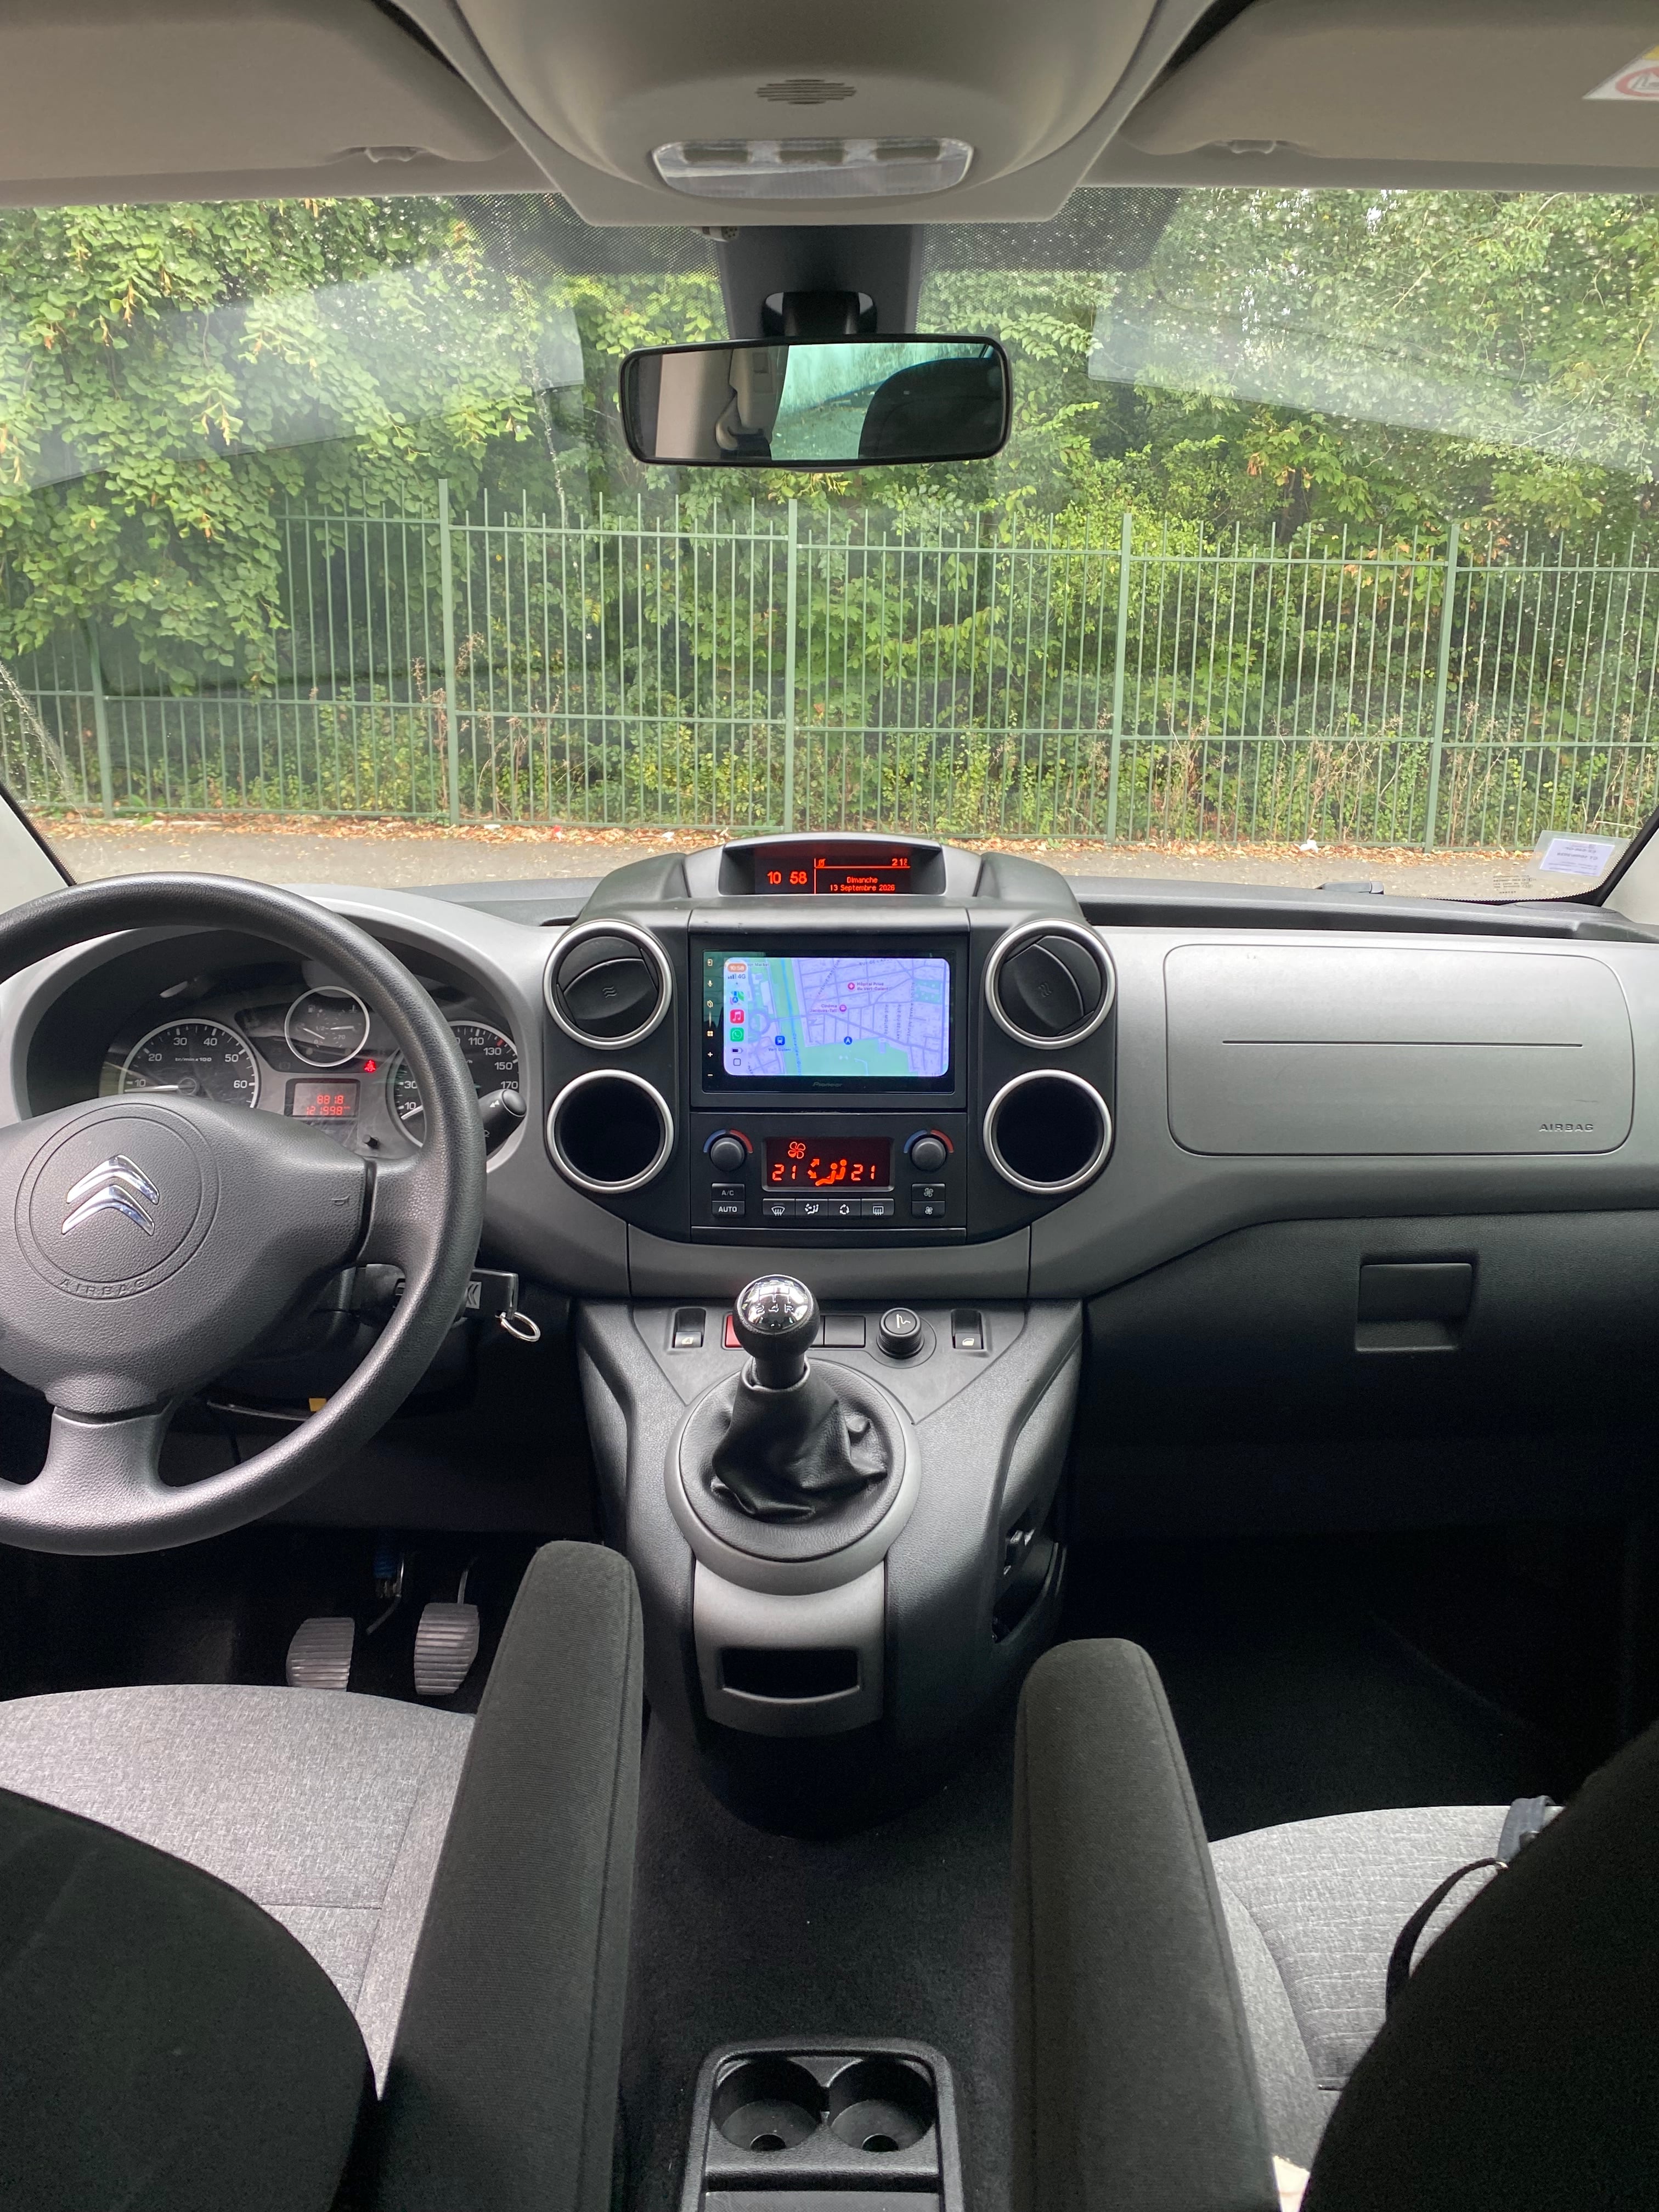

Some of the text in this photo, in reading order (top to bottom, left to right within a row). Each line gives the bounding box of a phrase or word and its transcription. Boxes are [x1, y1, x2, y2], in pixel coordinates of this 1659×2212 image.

[767, 871, 808, 884] 10 58
[840, 884, 877, 893] Septembre
[173, 1037, 187, 1046] 30
[204, 1037, 217, 1046] 40
[468, 1037, 484, 1046] 110
[483, 1047, 501, 1056] 130
[148, 1053, 162, 1062] 20
[224, 1054, 239, 1062] 50
[494, 1062, 513, 1070] 150
[233, 1080, 247, 1088] 60
[404, 1081, 417, 1089] 30
[500, 1081, 518, 1090] 170
[404, 1102, 416, 1110] 10
[1538, 1124, 1594, 1132] AIRBAG
[772, 1164, 796, 1181] 21
[851, 1164, 875, 1181] 21
[59, 1278, 147, 1295] AIRBAG
[756, 1304, 795, 1314] 2 4 R
